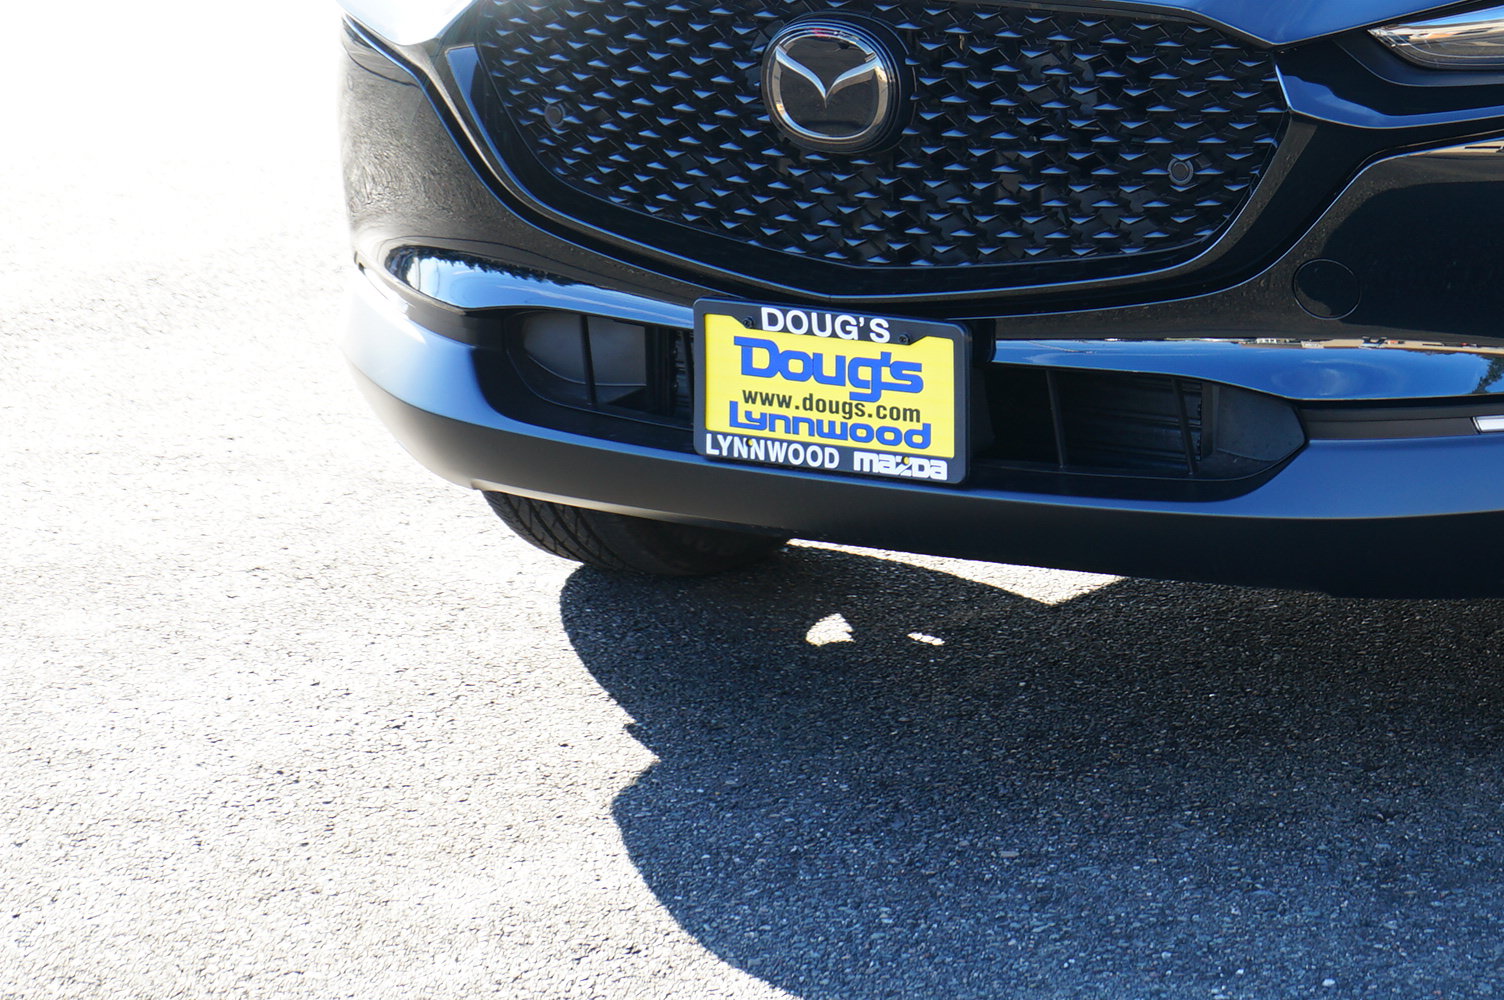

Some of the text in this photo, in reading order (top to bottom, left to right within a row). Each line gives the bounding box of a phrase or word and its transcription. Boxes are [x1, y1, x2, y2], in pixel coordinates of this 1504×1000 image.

[761, 306, 890, 344] DOUG'S
[734, 336, 924, 403] Doug's
[729, 400, 932, 450] Lynnwood
[742, 390, 921, 423] www.dougs.com
[705, 432, 840, 469] LYNNWOOD
